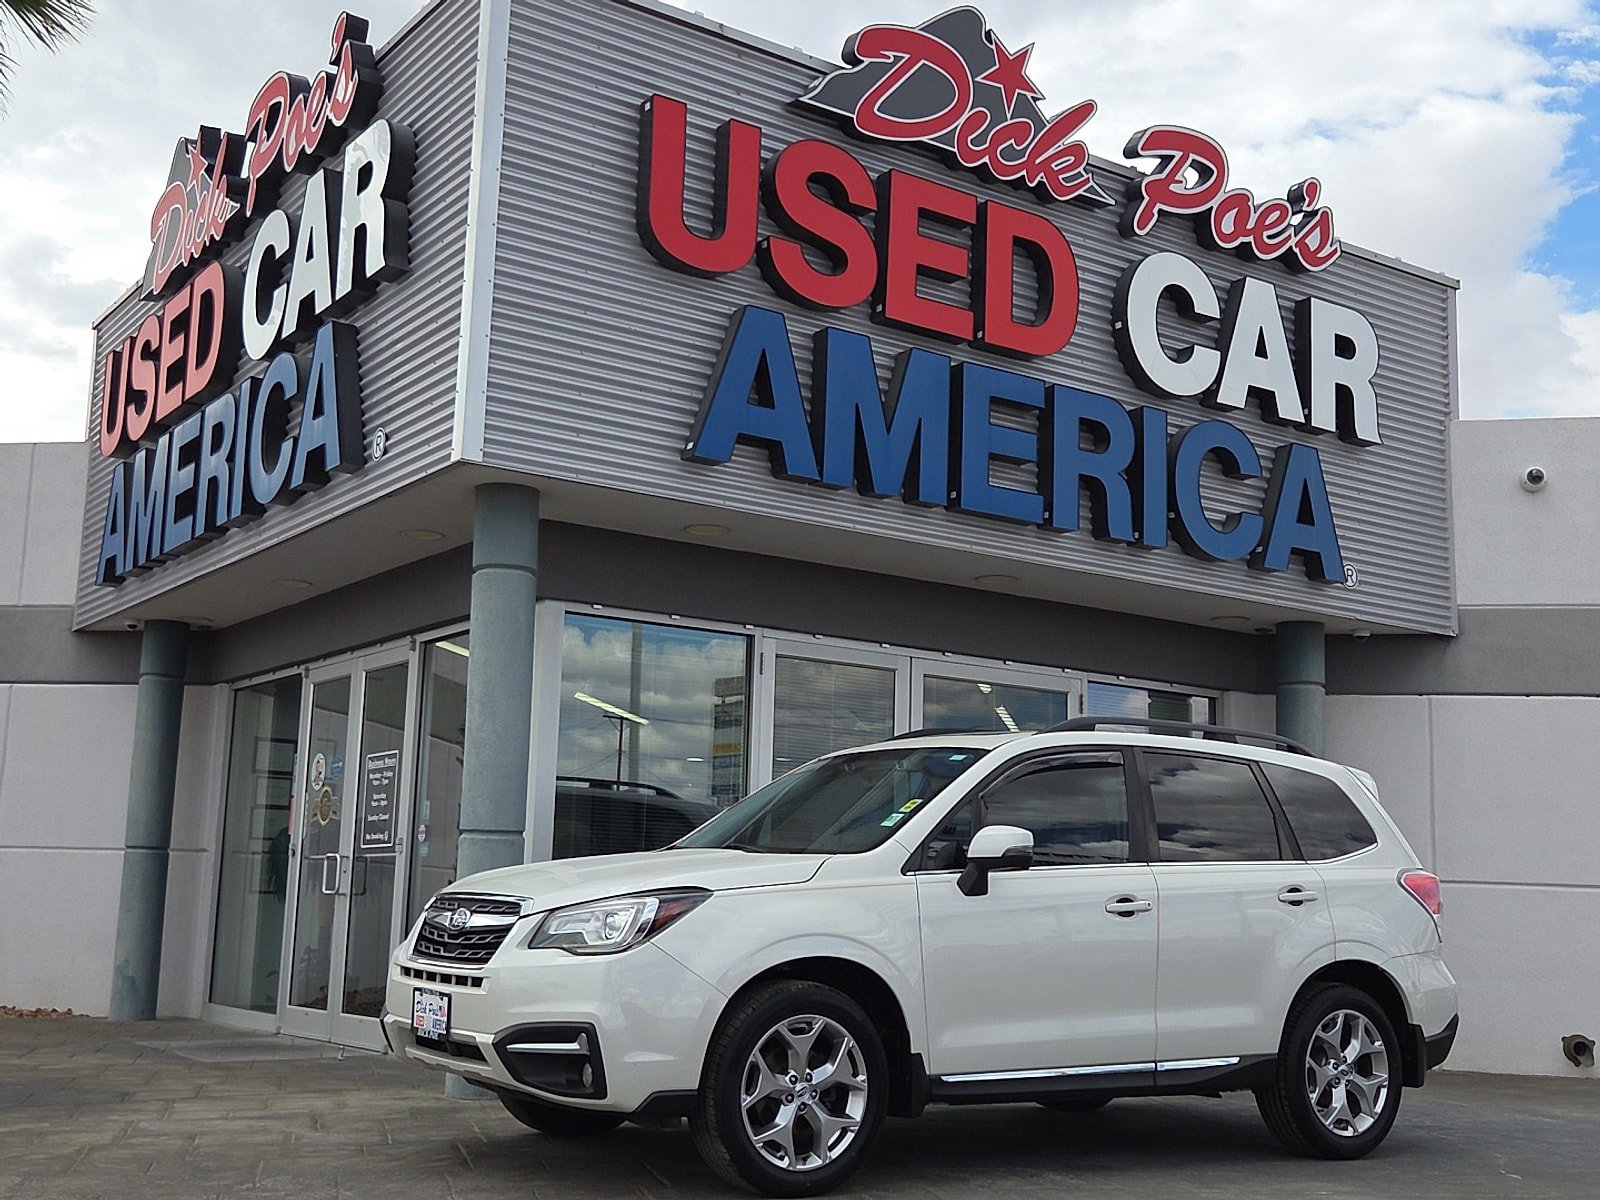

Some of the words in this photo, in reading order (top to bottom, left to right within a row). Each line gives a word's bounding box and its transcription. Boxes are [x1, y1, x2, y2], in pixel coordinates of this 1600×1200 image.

[99, 260, 226, 458] USED
[241, 118, 393, 361] CAR
[150, 132, 231, 296] Dick
[244, 10, 360, 217] Poe's
[646, 93, 1080, 360] USED
[1125, 251, 1384, 446] CAR
[850, 22, 1098, 200] Dick
[1133, 124, 1342, 272] Poe's
[95, 321, 343, 586] AMERICA
[692, 304, 1346, 585] AMERICA
